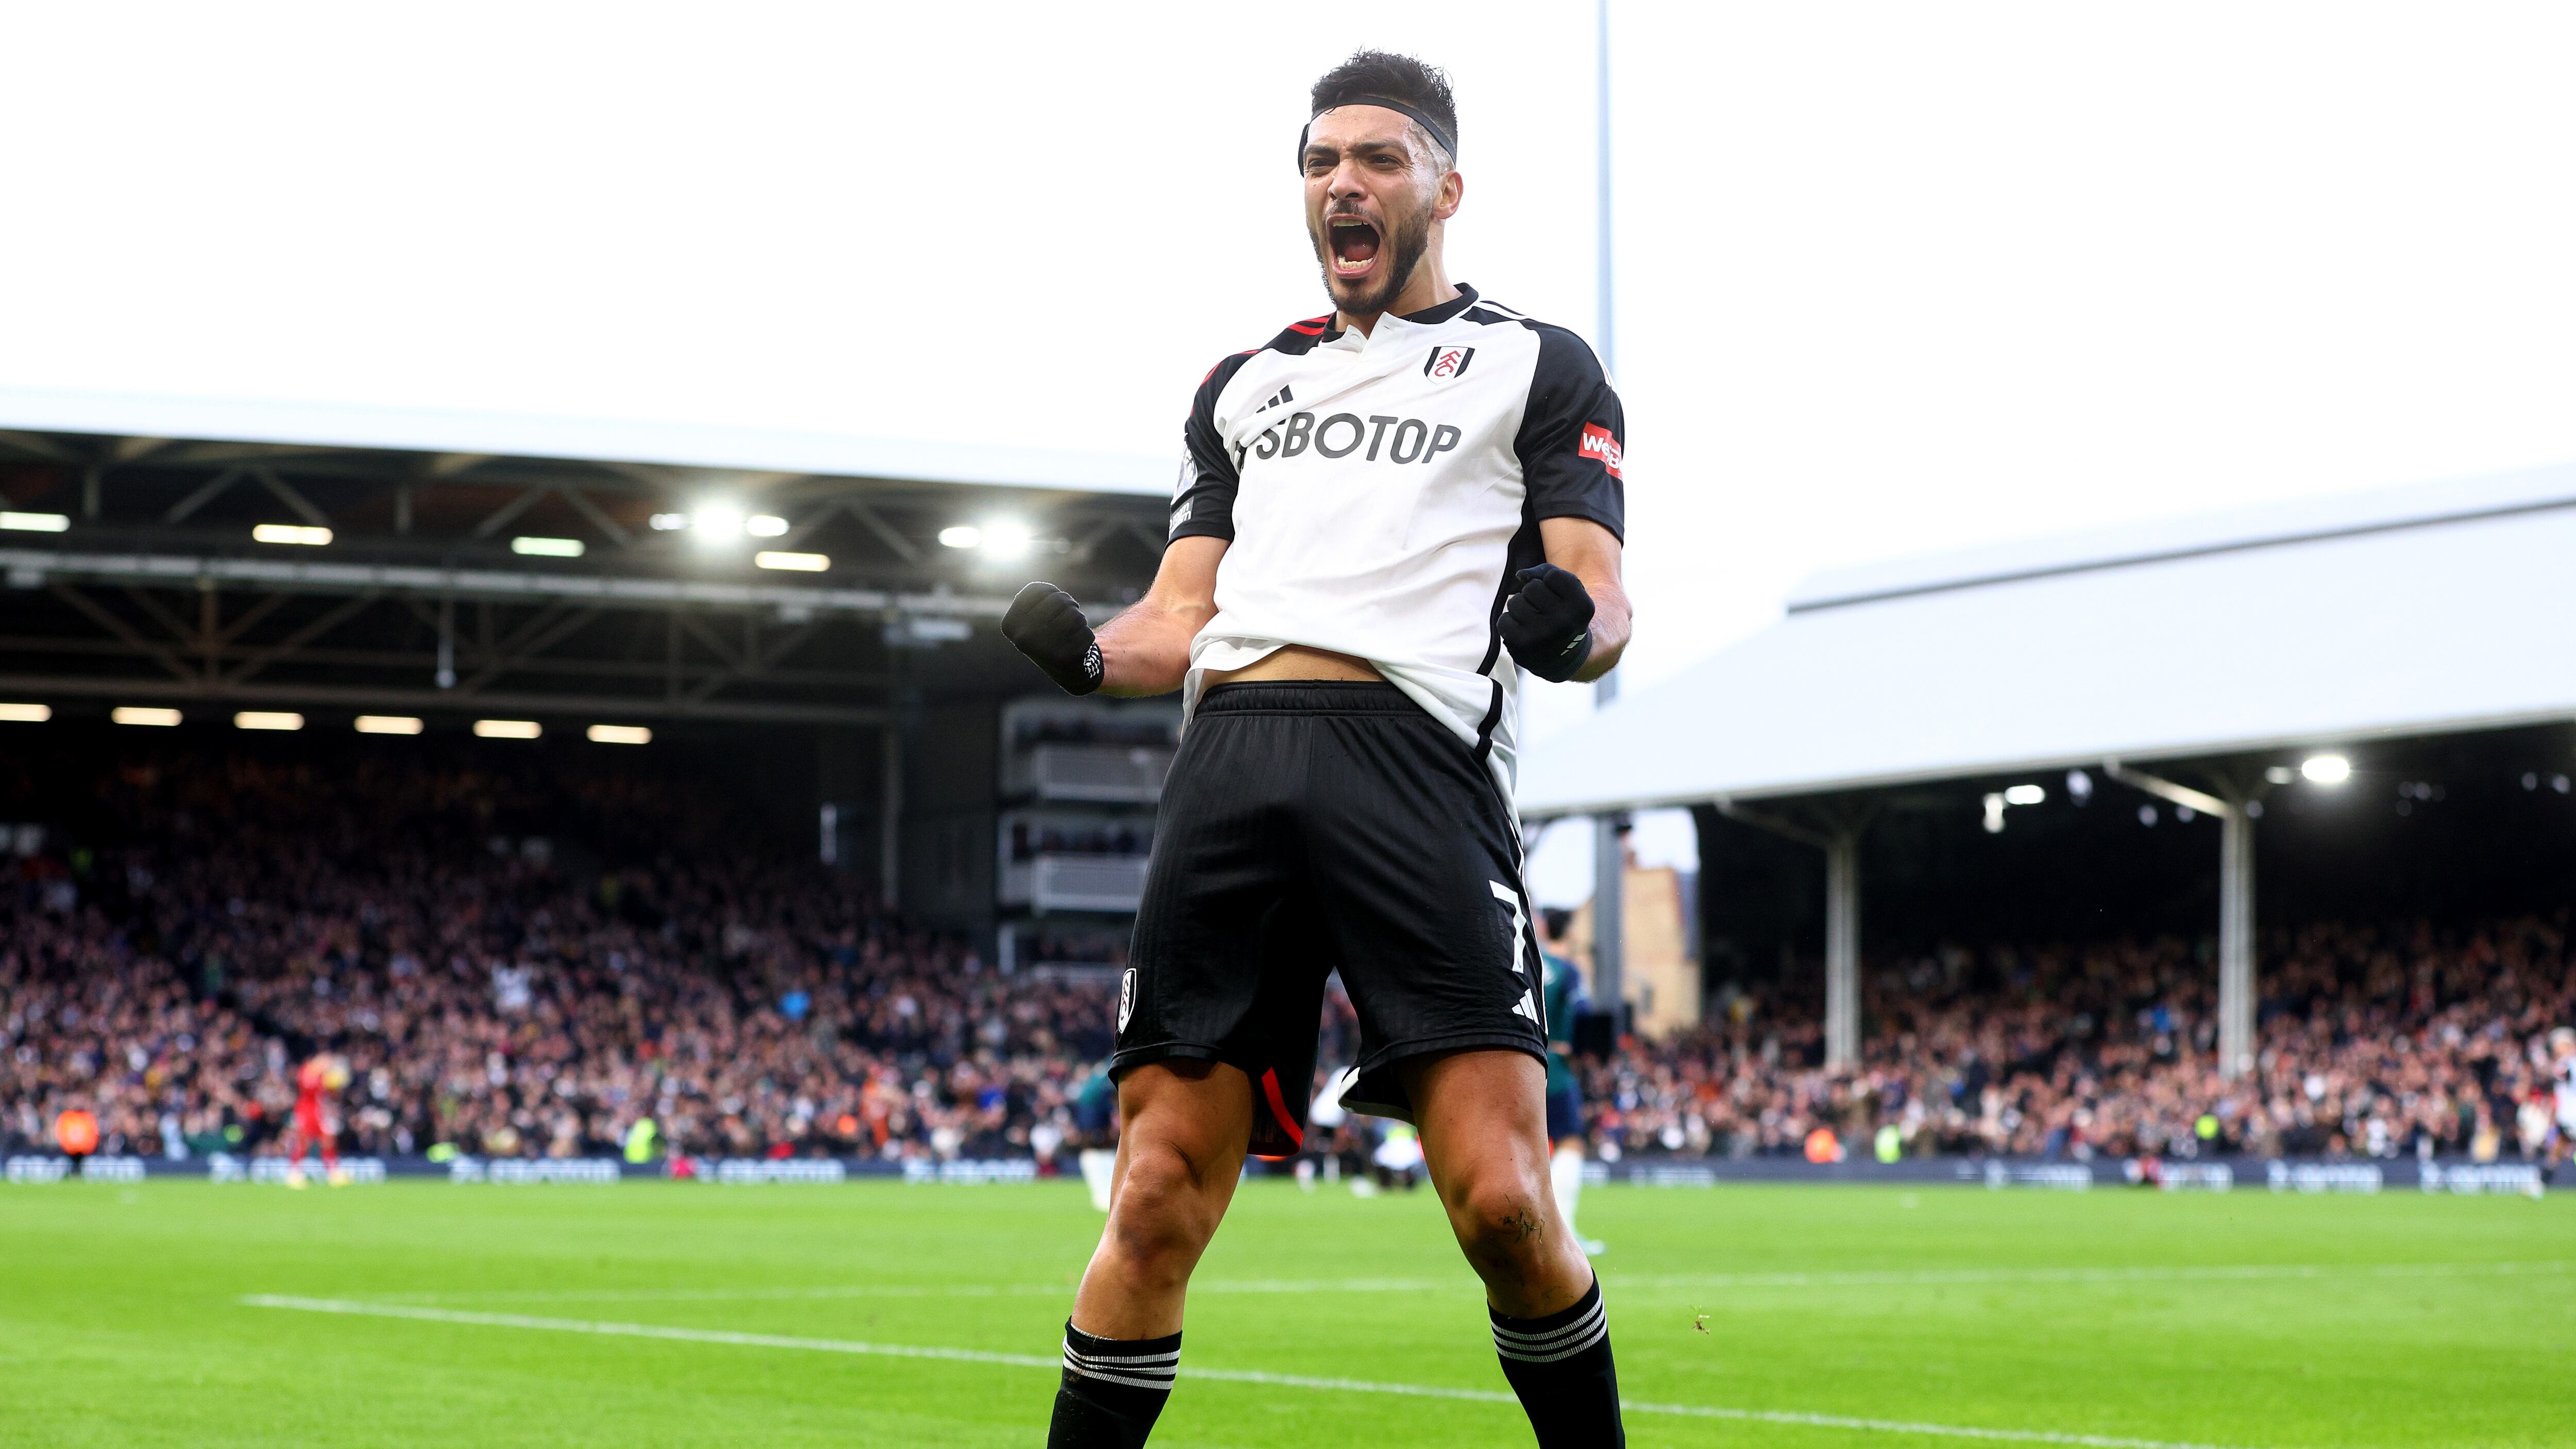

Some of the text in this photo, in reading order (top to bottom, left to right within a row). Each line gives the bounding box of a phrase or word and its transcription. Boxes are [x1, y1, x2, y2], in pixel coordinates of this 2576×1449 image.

[1434, 350, 1462, 377] FFC
[1256, 412, 1462, 464] SBOTOP
[1488, 879, 1527, 974] 7
